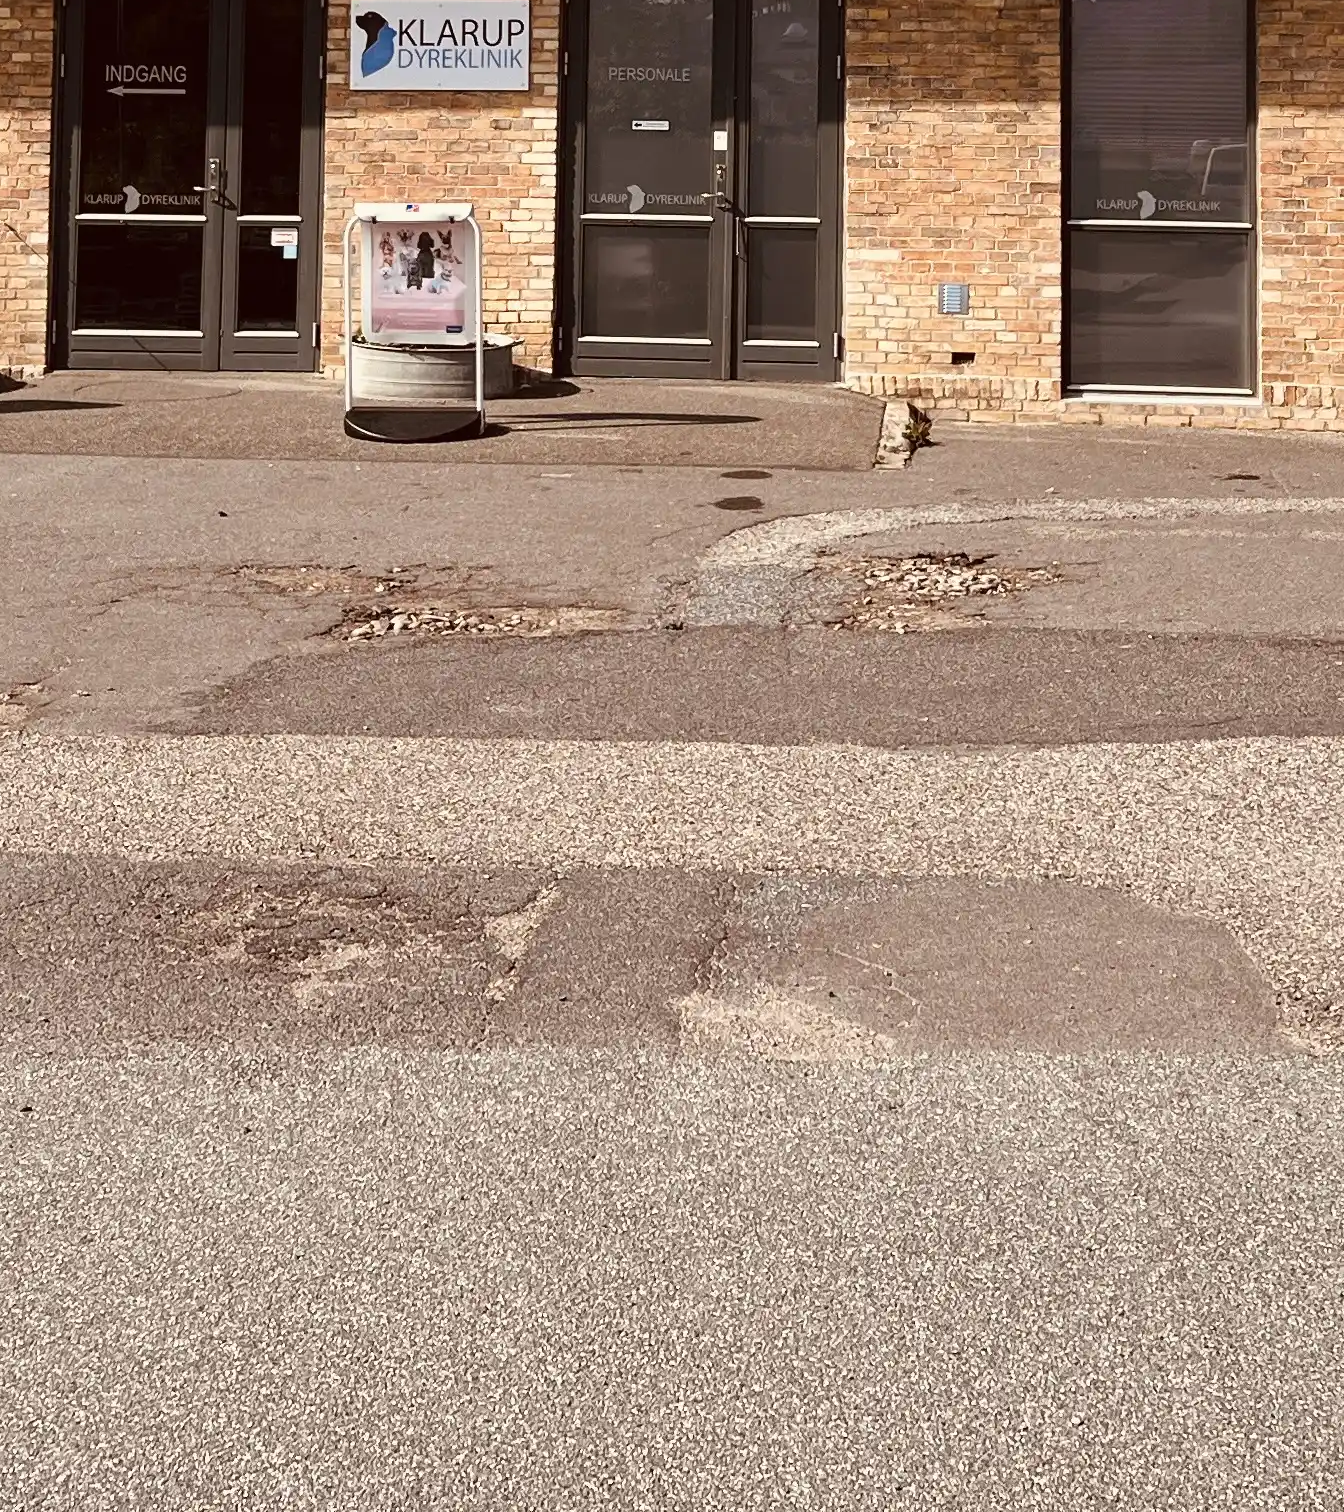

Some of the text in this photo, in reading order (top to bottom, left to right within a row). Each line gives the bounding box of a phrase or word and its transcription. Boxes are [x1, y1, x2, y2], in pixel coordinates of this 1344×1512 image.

[398, 19, 525, 47] KLARUP
[398, 48, 523, 69] DYREKLINIK
[105, 64, 187, 83] INDGANG
[608, 67, 691, 82] PERSONALE
[84, 193, 201, 206] KLARUP DYREKLINIK
[588, 193, 707, 206] KLARUP DYREKLINIK
[1096, 199, 1221, 211] KLARUP DYREKLINIK
